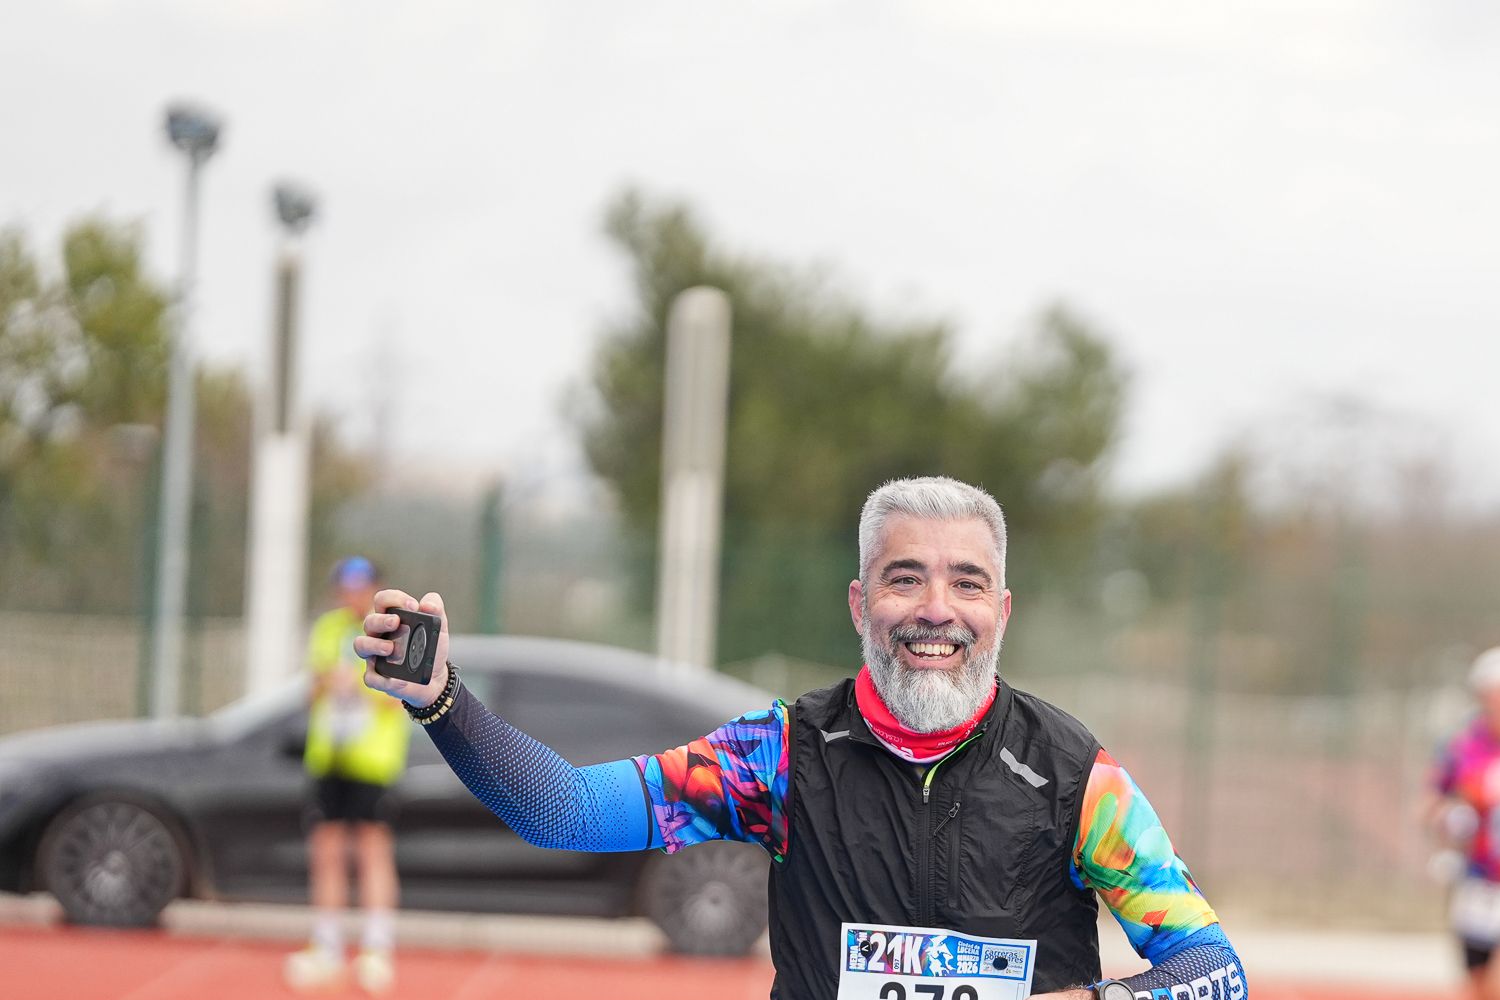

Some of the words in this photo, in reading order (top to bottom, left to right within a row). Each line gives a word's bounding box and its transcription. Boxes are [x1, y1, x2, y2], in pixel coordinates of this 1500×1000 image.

[868, 932, 924, 976] 21K
[984, 949, 1018, 959] carreras
[984, 954, 1024, 964] poares
[956, 961, 979, 975] 2026
